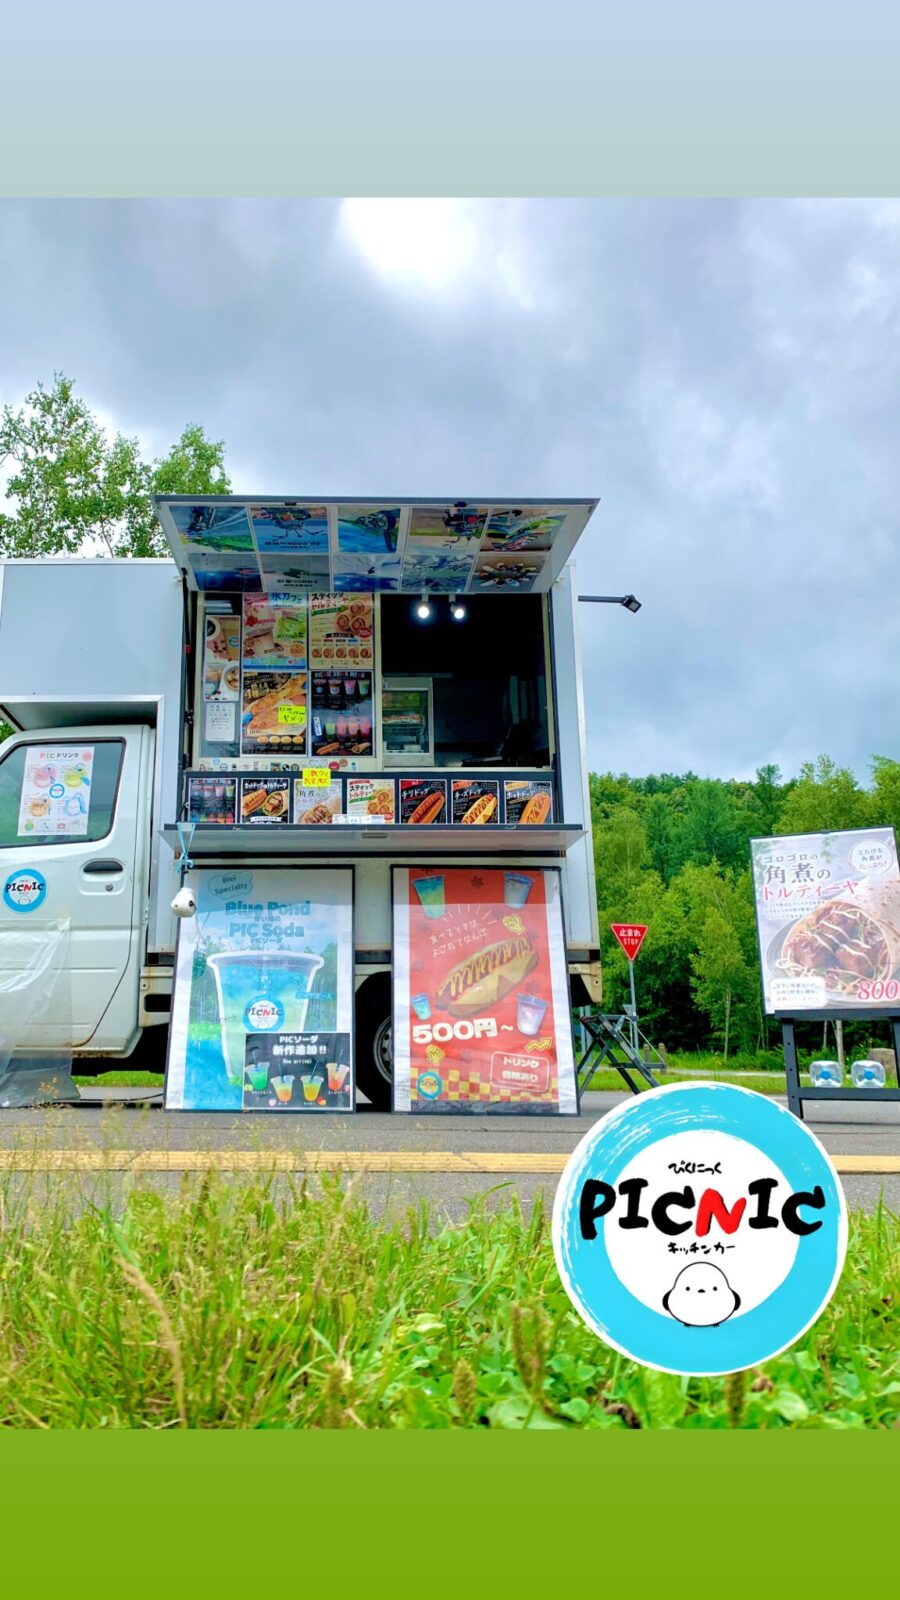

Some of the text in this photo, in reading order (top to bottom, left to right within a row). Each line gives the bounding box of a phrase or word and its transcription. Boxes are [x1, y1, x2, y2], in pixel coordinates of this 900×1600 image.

[402, 788, 430, 800] チリドッグ
[764, 852, 818, 864] ゴロゴロの
[765, 862, 831, 884] 角煮の
[222, 875, 236, 884] Biei
[6, 881, 45, 892] PICNIC
[214, 882, 248, 895] Specialty
[764, 880, 860, 901] トルティーヤ
[225, 900, 311, 916] Blue Pond
[229, 922, 305, 938] PIC Soda
[620, 928, 642, 937] 止まれ
[624, 938, 639, 946] STOP
[244, 1007, 283, 1016] PICNIC
[279, 1034, 318, 1044] PICソーダ
[502, 1056, 540, 1069] ドリンク
